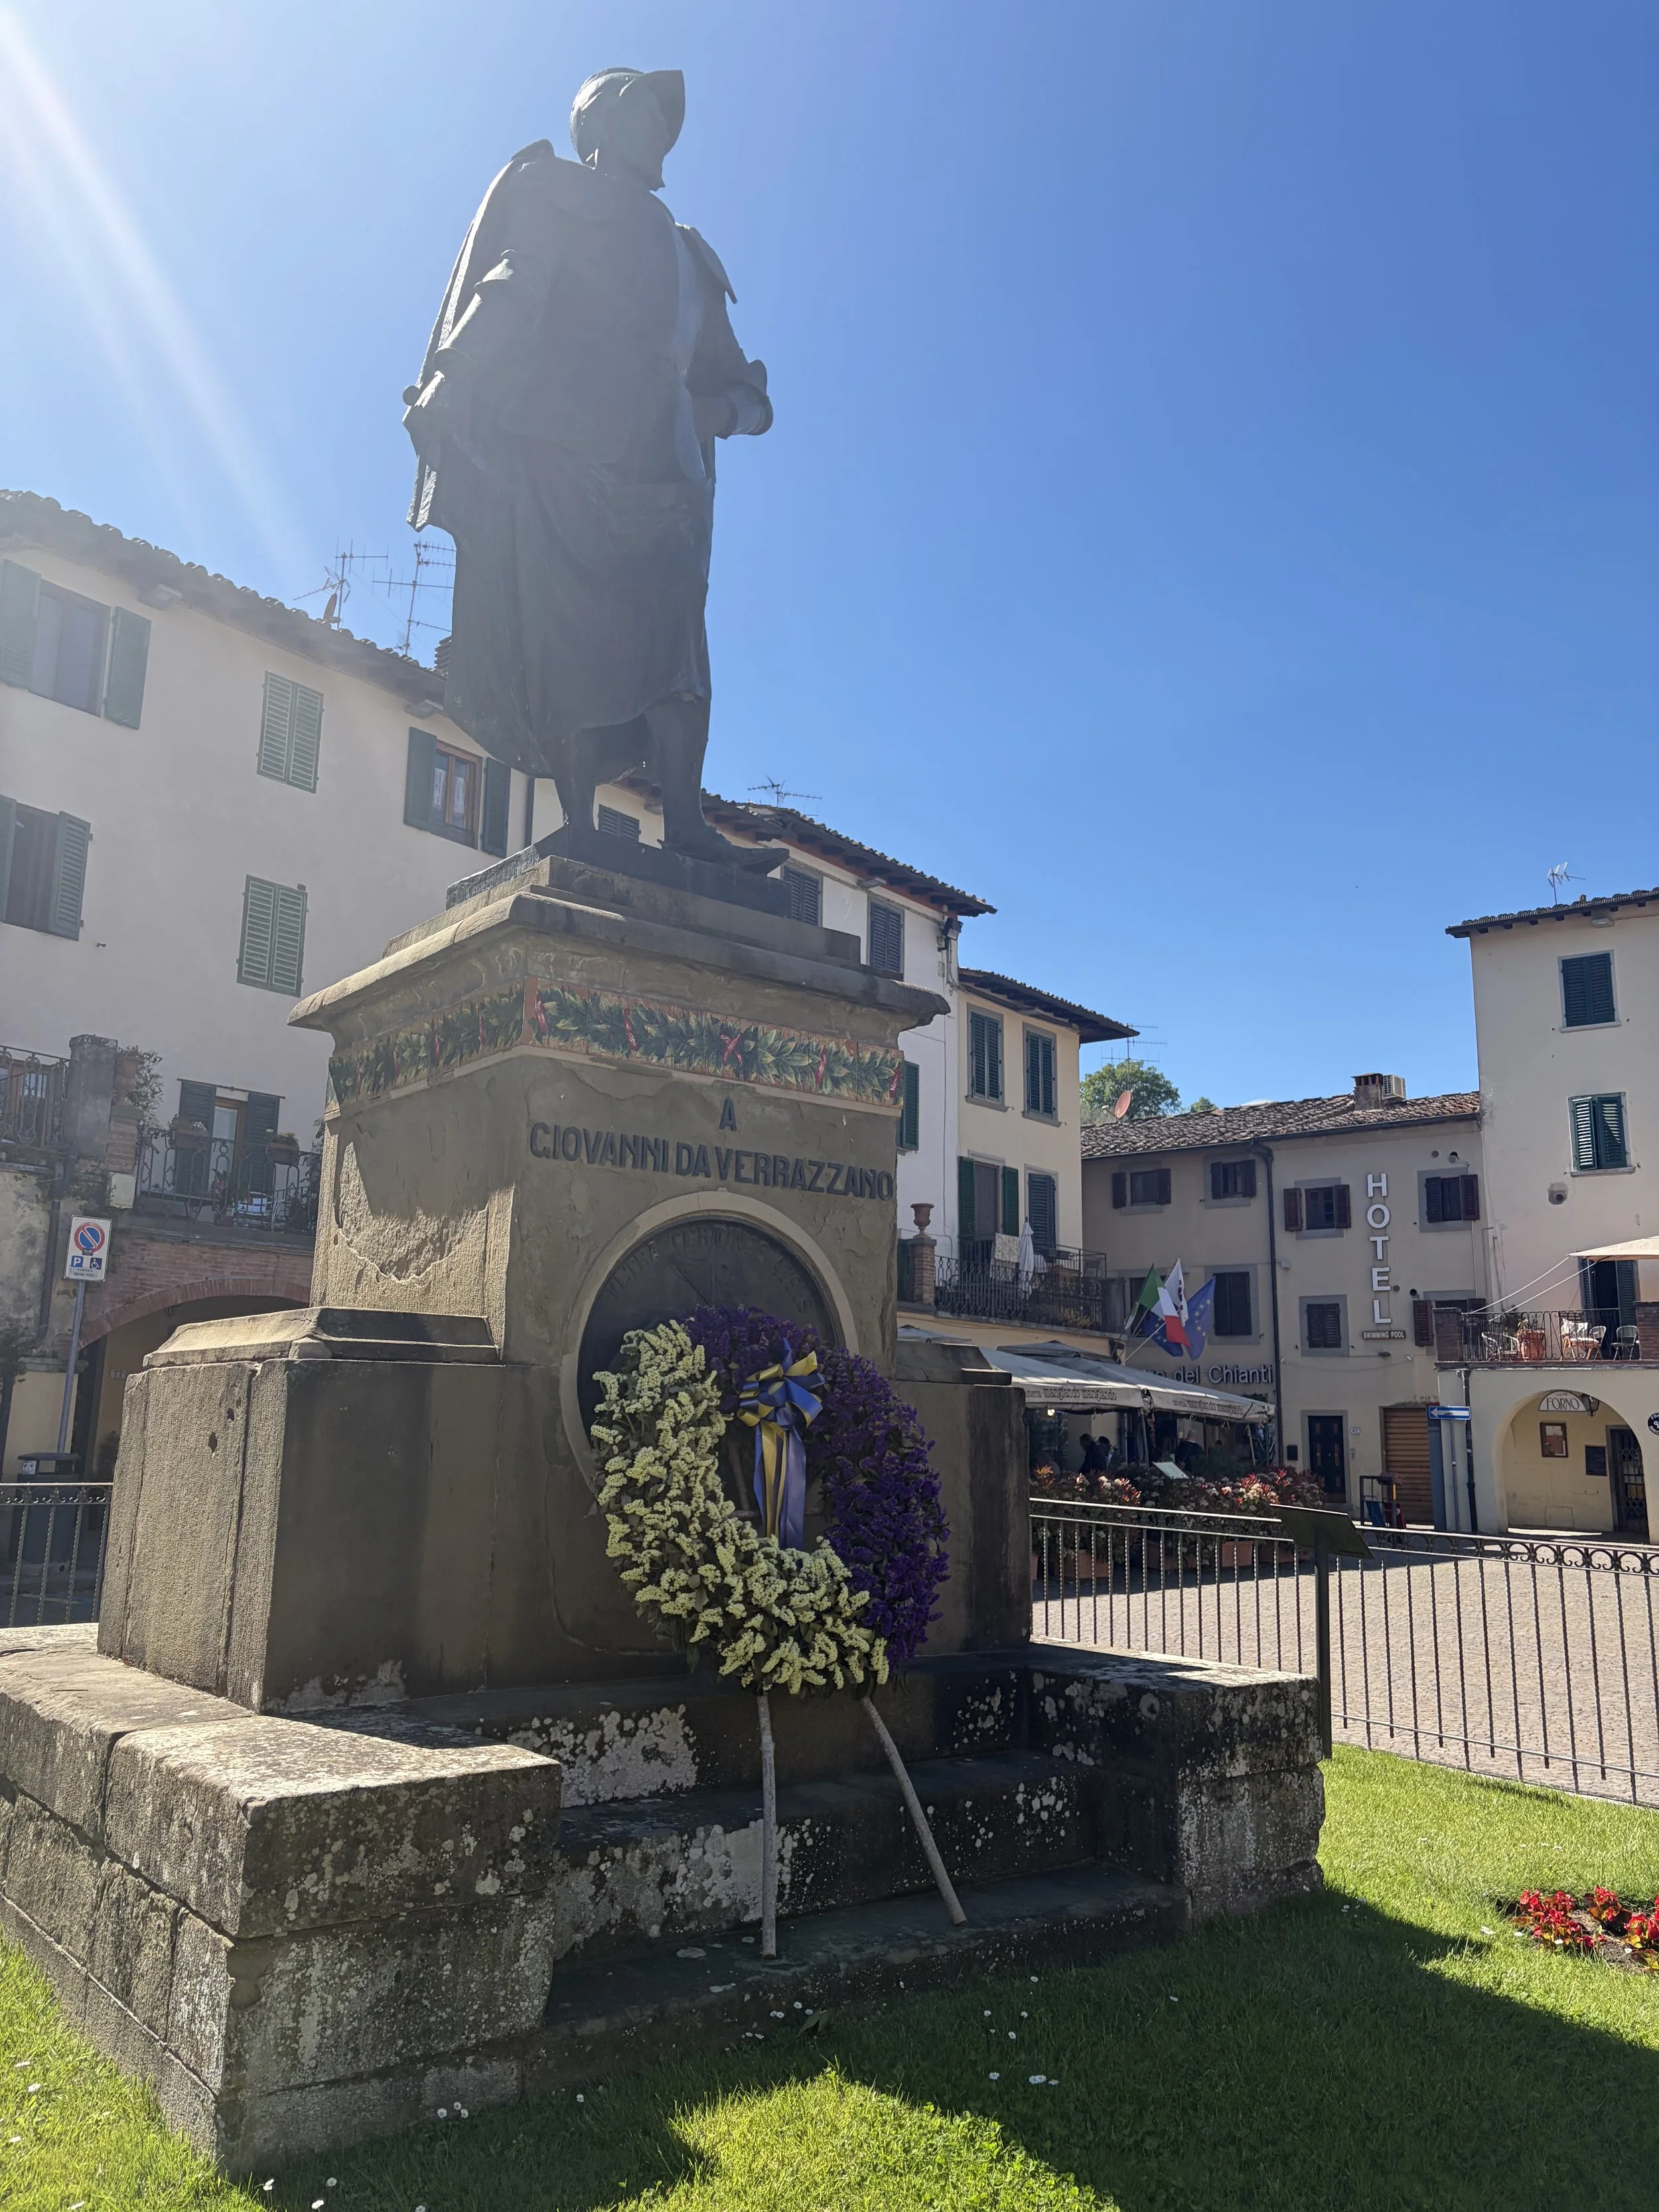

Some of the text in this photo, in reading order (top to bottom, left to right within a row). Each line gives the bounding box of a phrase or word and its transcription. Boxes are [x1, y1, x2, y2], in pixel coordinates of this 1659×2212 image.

[719, 1098, 737, 1131] A
[530, 1122, 893, 1201] GIOVANNI DA VERRAZZANO
[1367, 1173, 1392, 1323] HOTEL
[73, 1257, 82, 1267] P
[1174, 1364, 1200, 1384] del
[1208, 1364, 1273, 1383] Chianti
[1082, 1388, 1117, 1402] mangiando
[1546, 1397, 1579, 1410] FORNO
